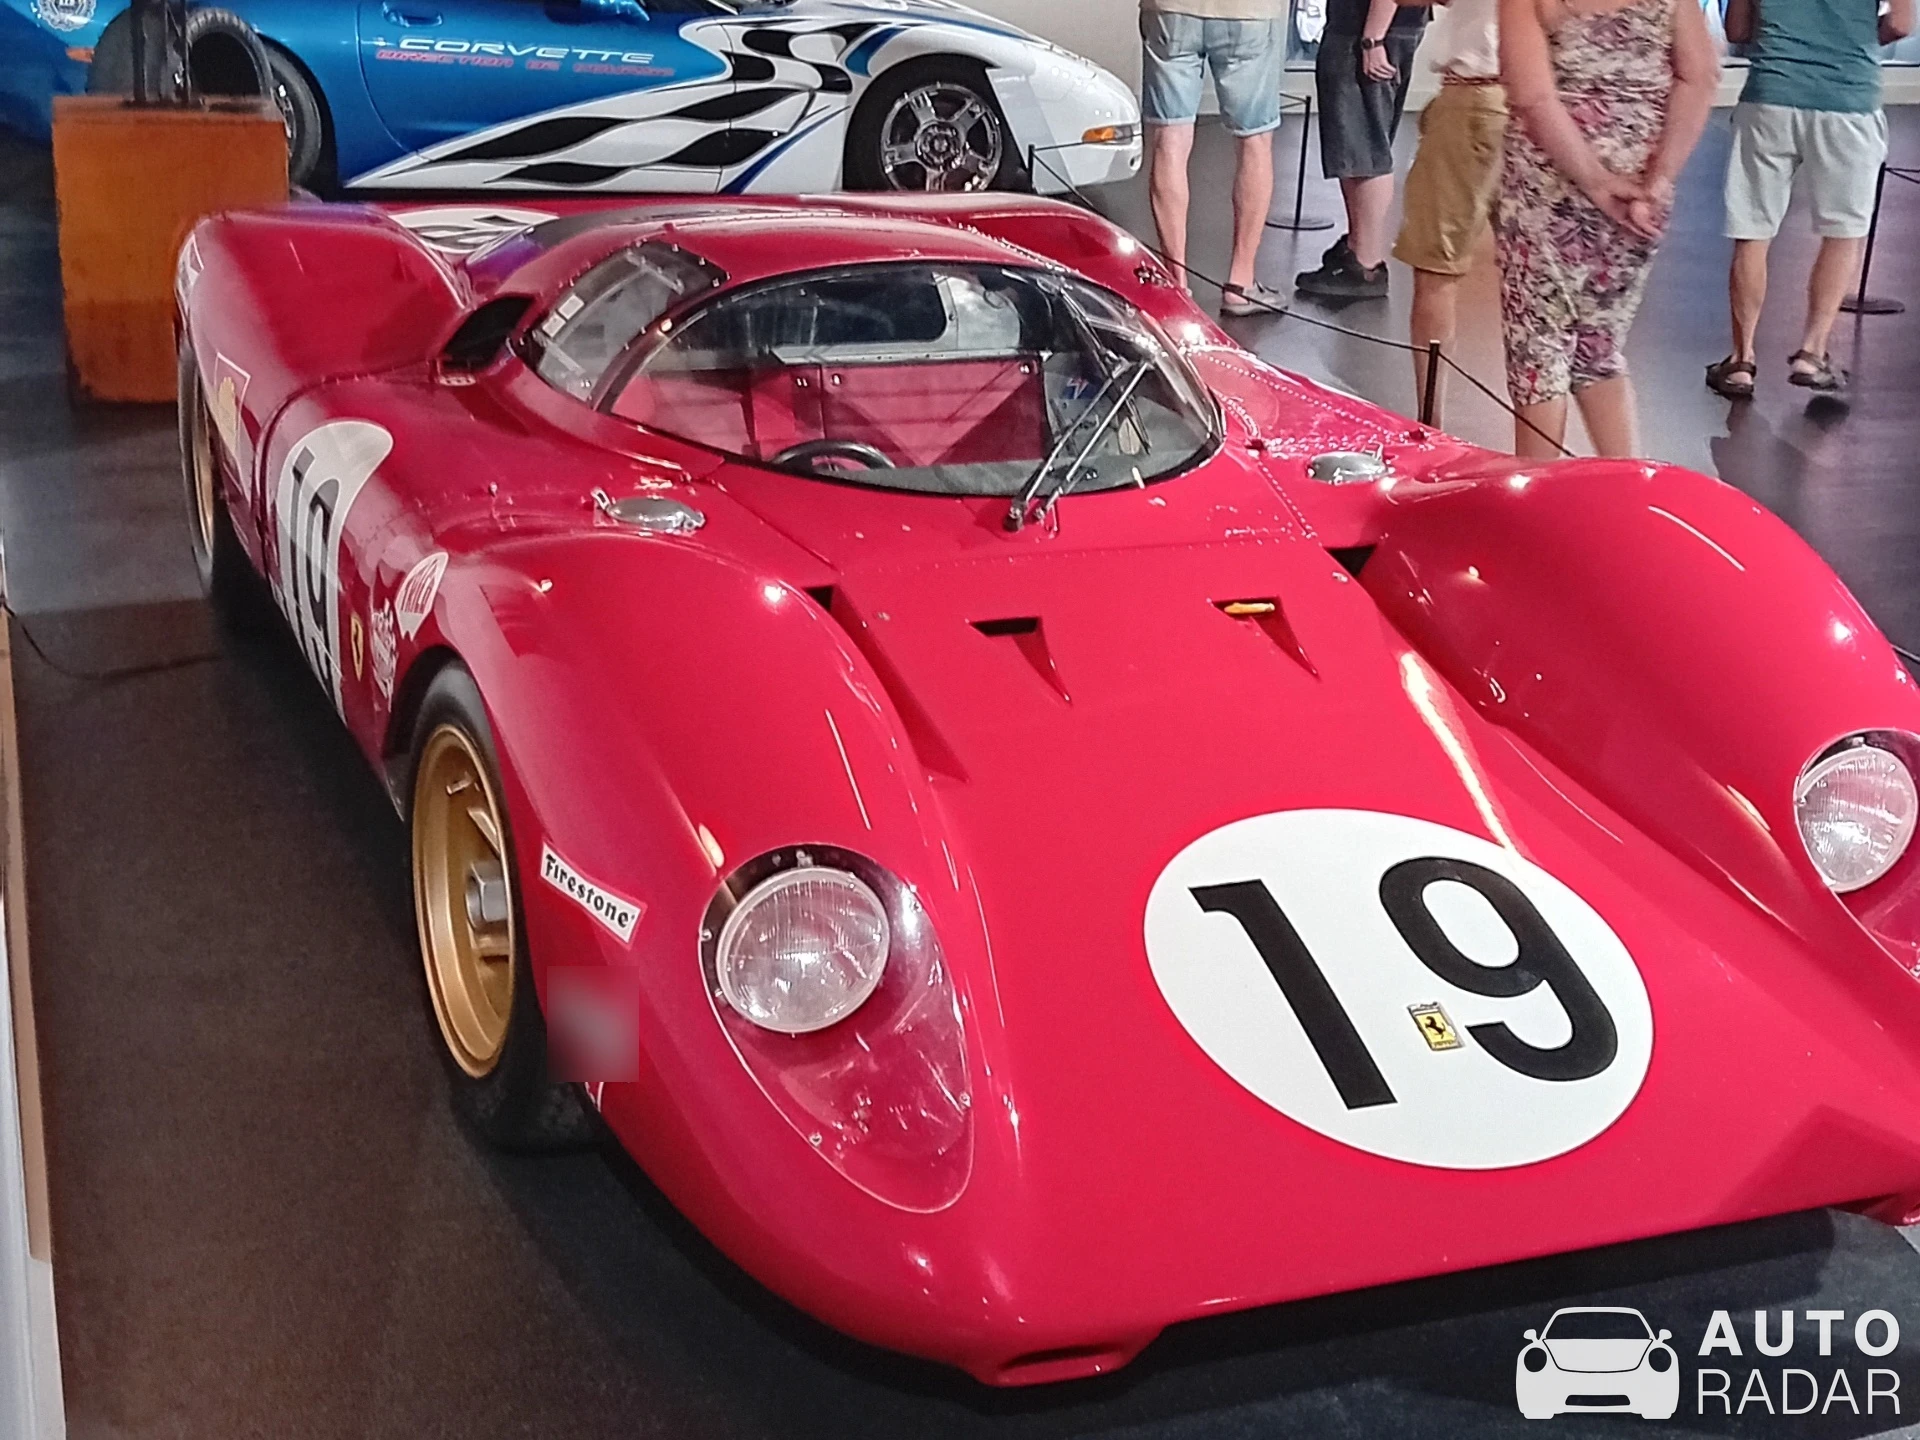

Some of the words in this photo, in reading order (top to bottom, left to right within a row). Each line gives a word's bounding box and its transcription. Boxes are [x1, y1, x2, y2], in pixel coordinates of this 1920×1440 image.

[400, 36, 654, 64] CORVETTE
[545, 853, 635, 929] Firestone
[1189, 856, 1618, 1110] 19
